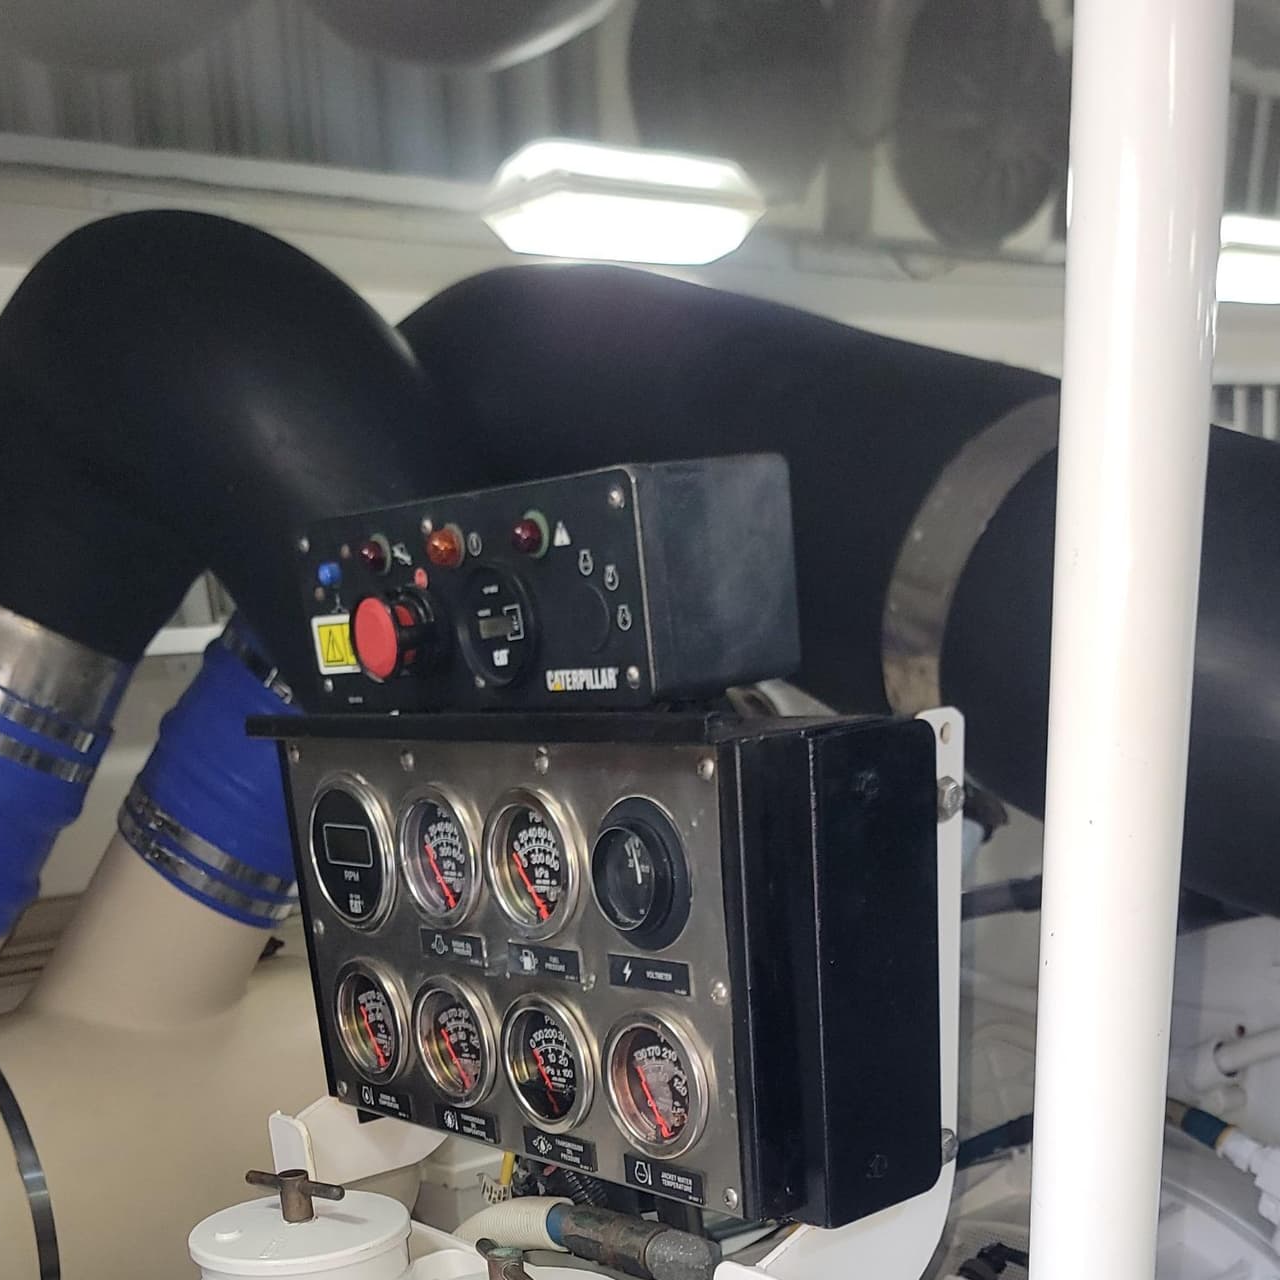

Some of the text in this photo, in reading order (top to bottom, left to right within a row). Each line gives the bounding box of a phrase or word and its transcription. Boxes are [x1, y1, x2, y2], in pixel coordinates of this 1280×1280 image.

[545, 667, 619, 692] CATERPILLAR
[344, 870, 360, 882] RPM
[646, 970, 673, 982] VOLTMETER
[544, 1028, 558, 1039] 200
[647, 1046, 661, 1058] 170
[662, 1047, 677, 1061] 210
[661, 1171, 677, 1182] JACKET
[662, 1178, 693, 1194] TEMPERATURE
